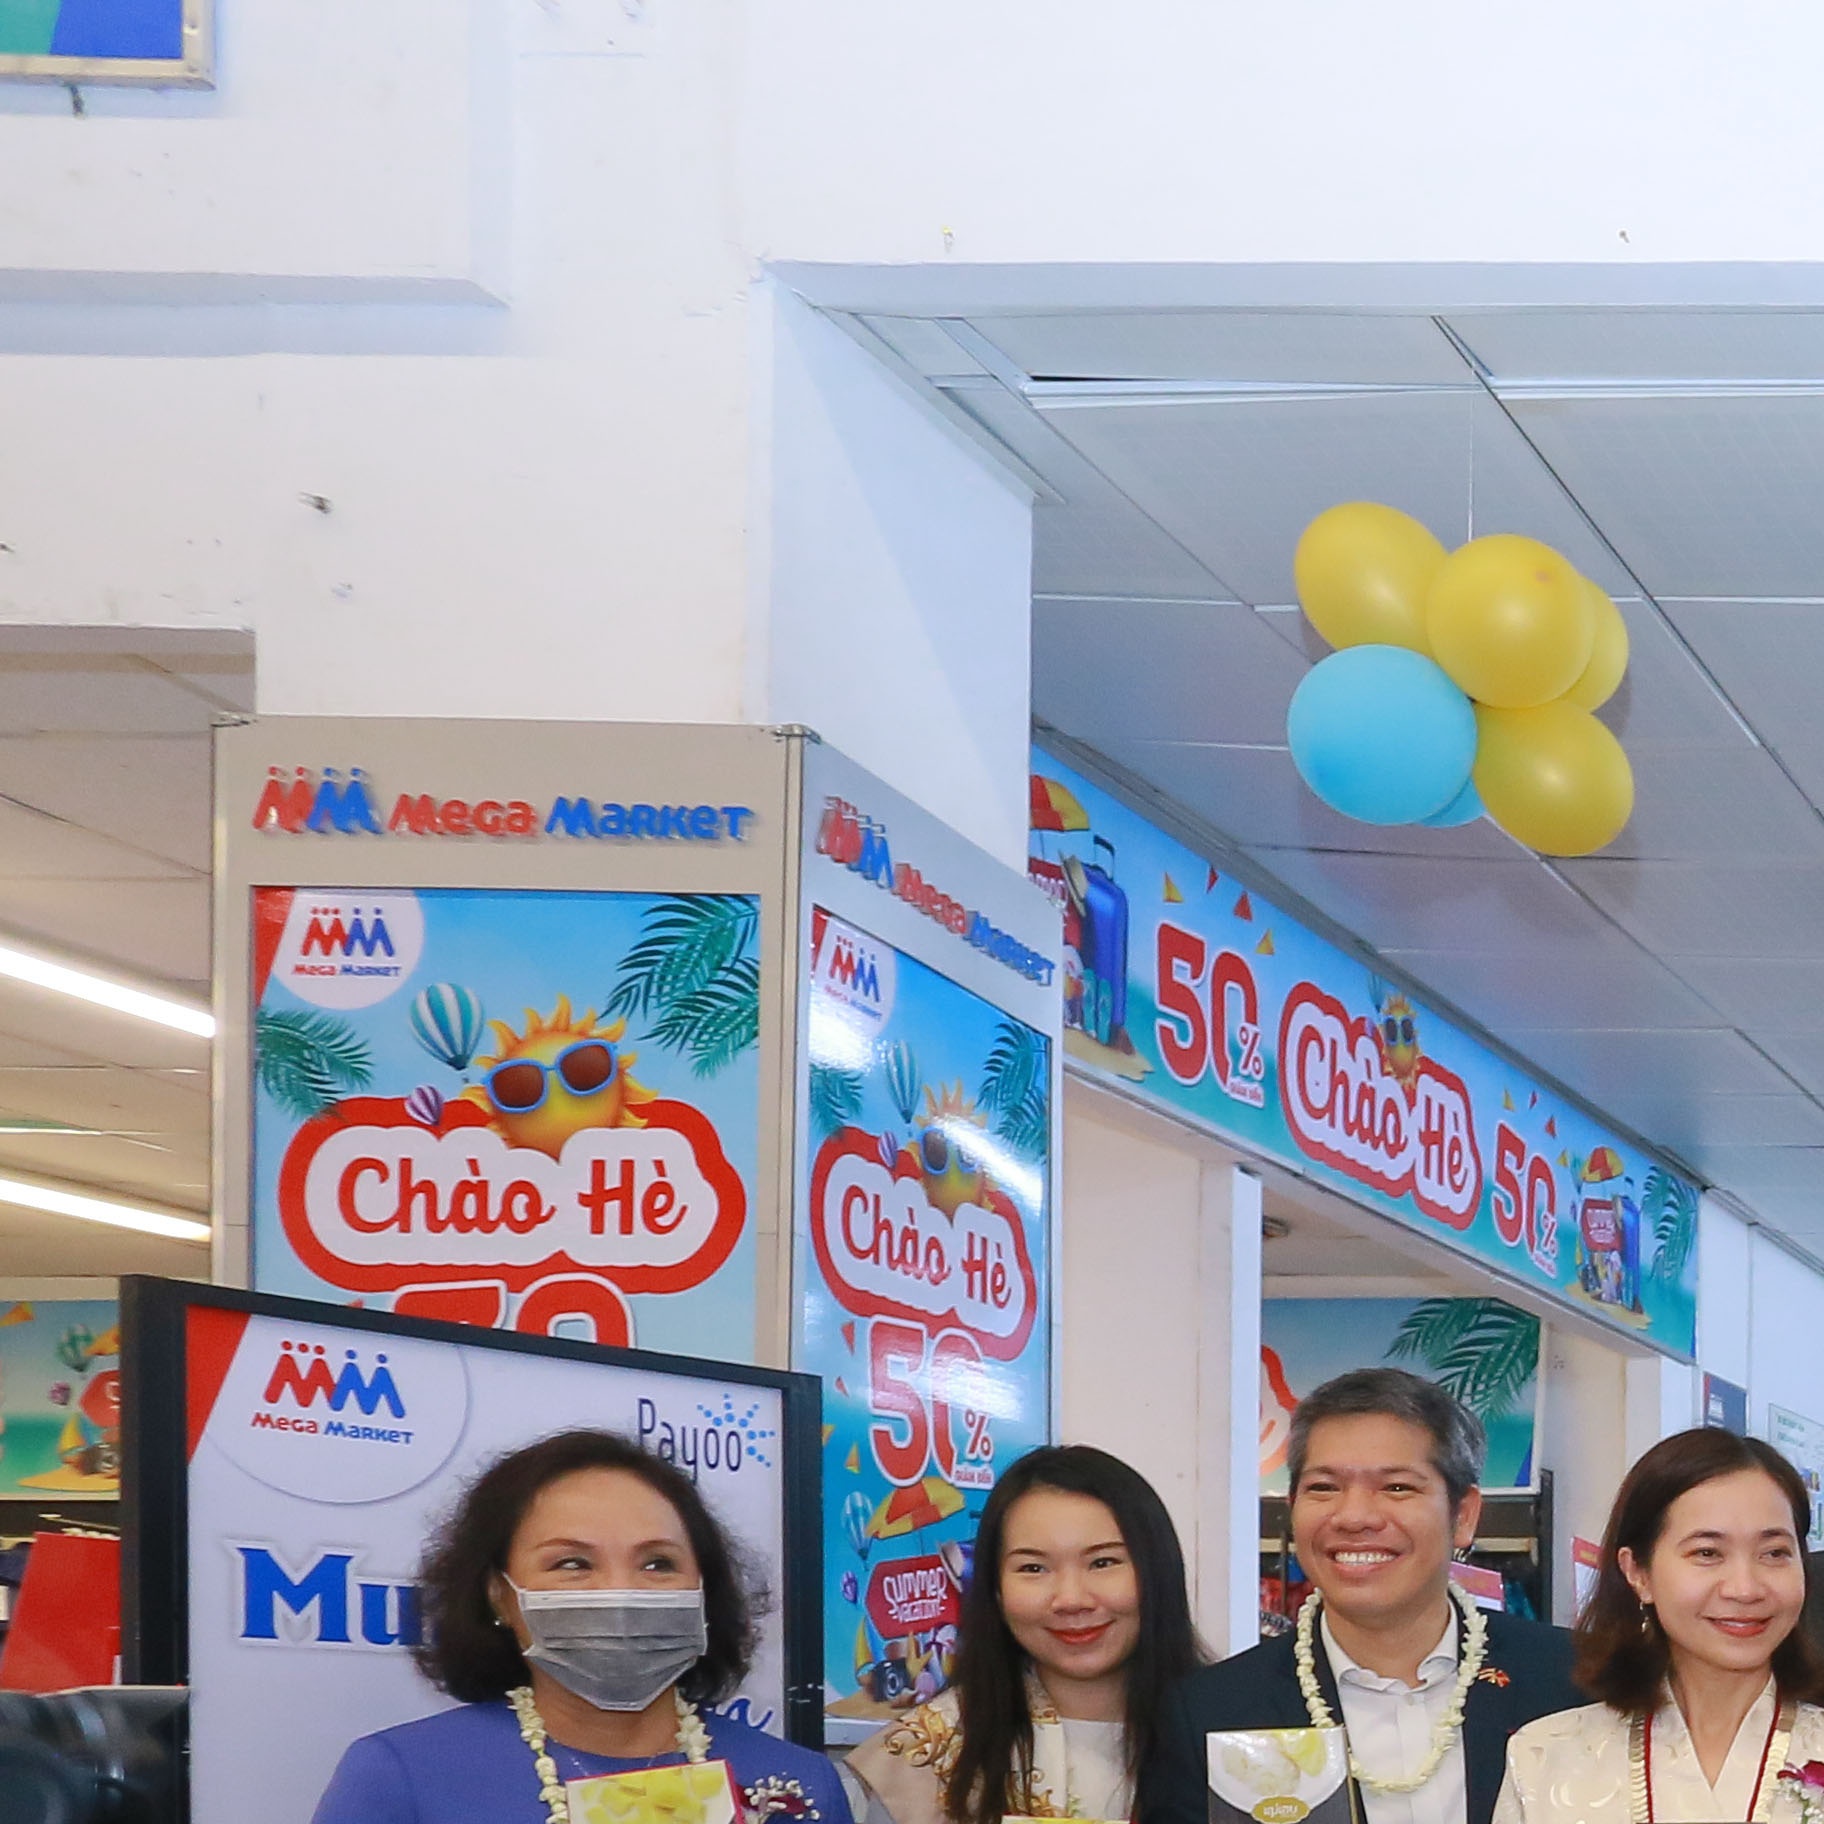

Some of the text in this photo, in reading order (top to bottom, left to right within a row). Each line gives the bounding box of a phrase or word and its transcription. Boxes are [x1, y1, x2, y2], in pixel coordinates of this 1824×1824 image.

[1299, 1023, 1470, 1192] Chào Hè
[339, 1154, 689, 1237] Chào Hè
[841, 1184, 1013, 1310] Chào Hè
[636, 1396, 743, 1486] Payoo
